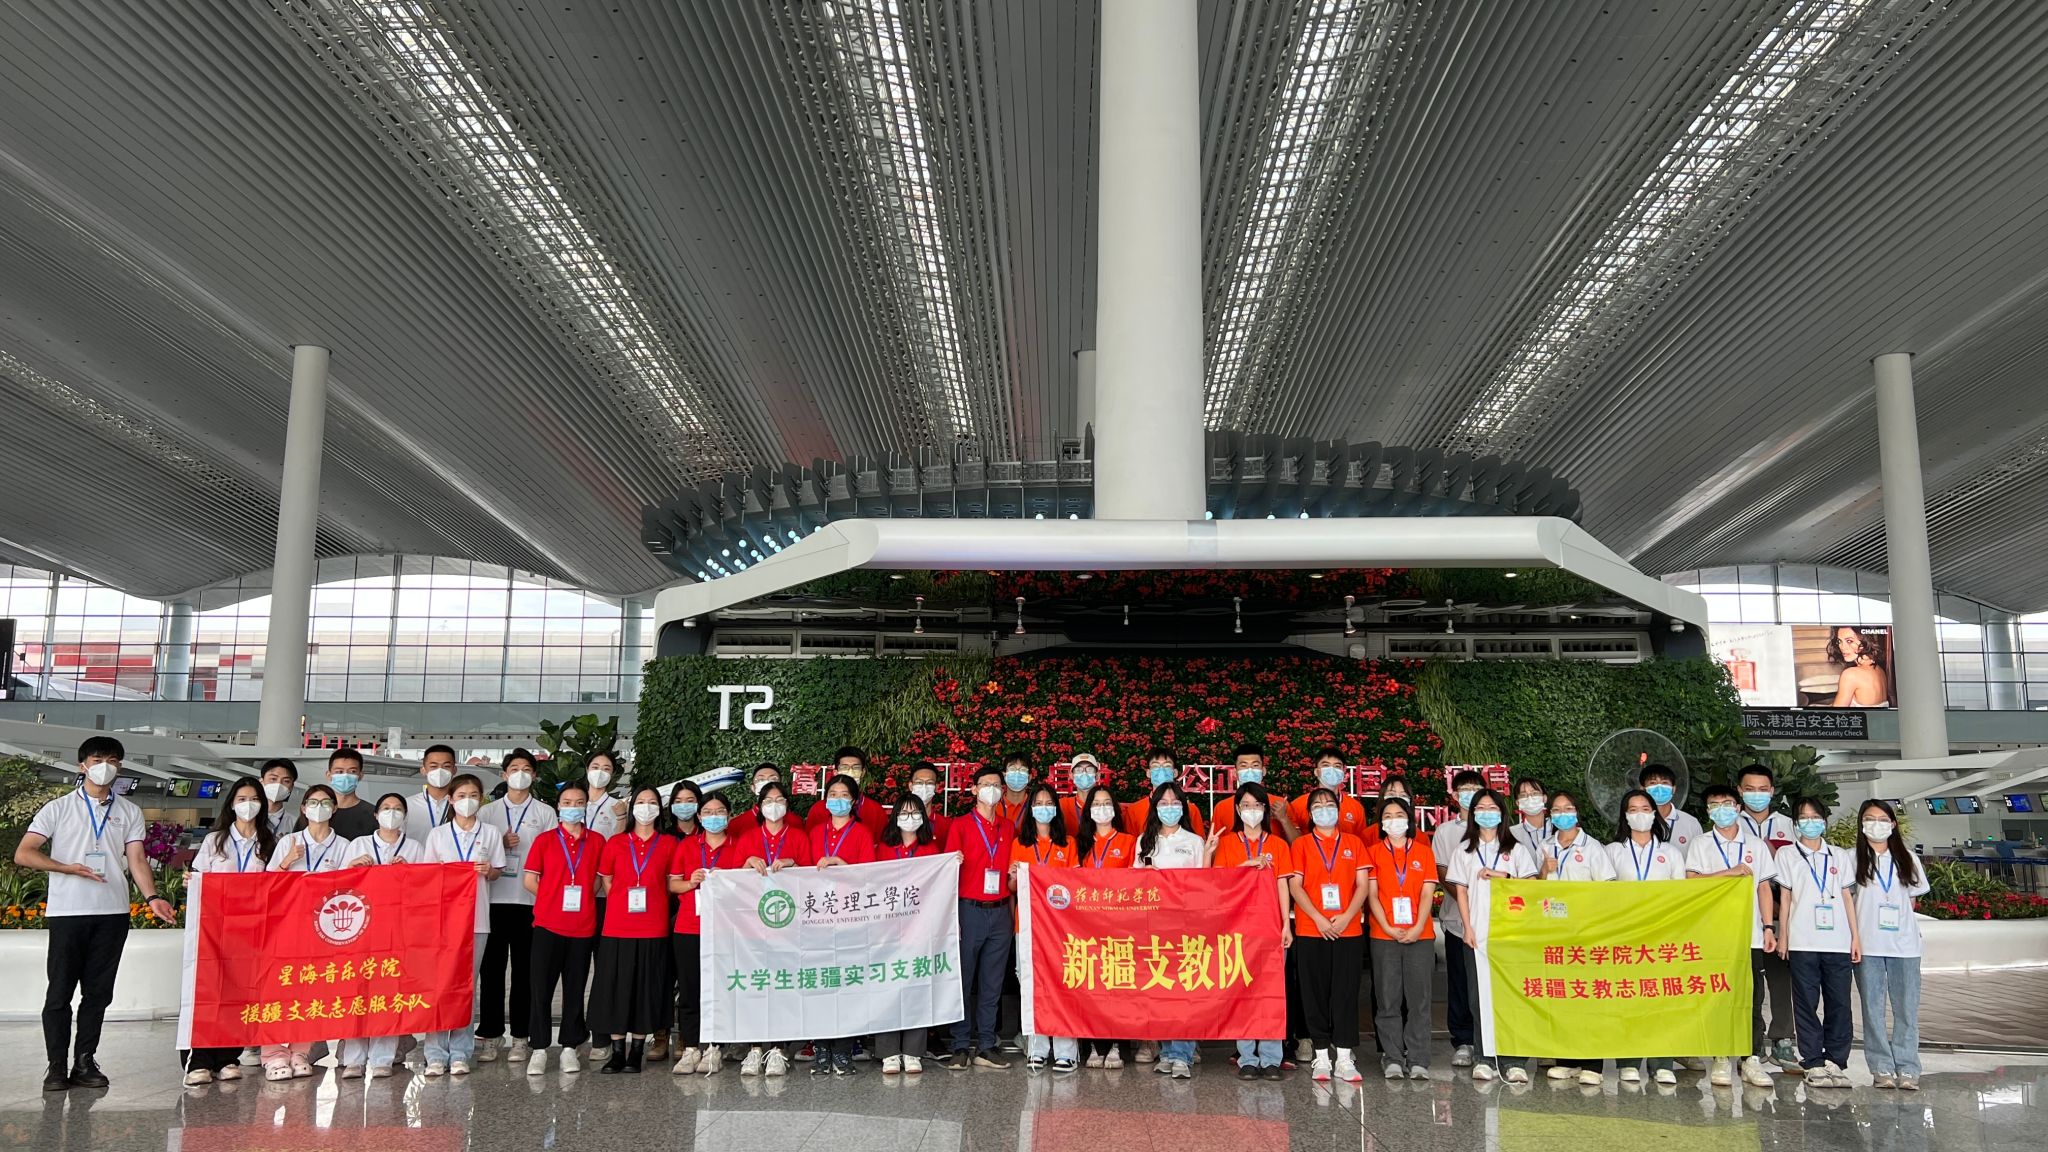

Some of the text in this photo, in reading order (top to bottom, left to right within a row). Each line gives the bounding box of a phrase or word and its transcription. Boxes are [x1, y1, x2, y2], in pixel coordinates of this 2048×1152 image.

[707, 685, 774, 730] T2
[1761, 729, 1817, 738] HK/Macau/Taiwan
[1817, 730, 1843, 738] Security
[1844, 730, 1864, 738] Check
[802, 885, 921, 918] 東莞理工學院
[836, 915, 870, 924] UNIVERSITY
[885, 910, 921, 920] TECHNOLOGY
[1062, 932, 1253, 992] 新疆支教队
[1543, 942, 1702, 966] 韶关学院大学生
[278, 957, 401, 986] 星海音乐学院
[727, 953, 953, 992] 大学生援疆实习支教队
[1523, 972, 1731, 999] 援疆支教志愿服务队
[240, 992, 431, 1025] 援疆支教志愿服务队
